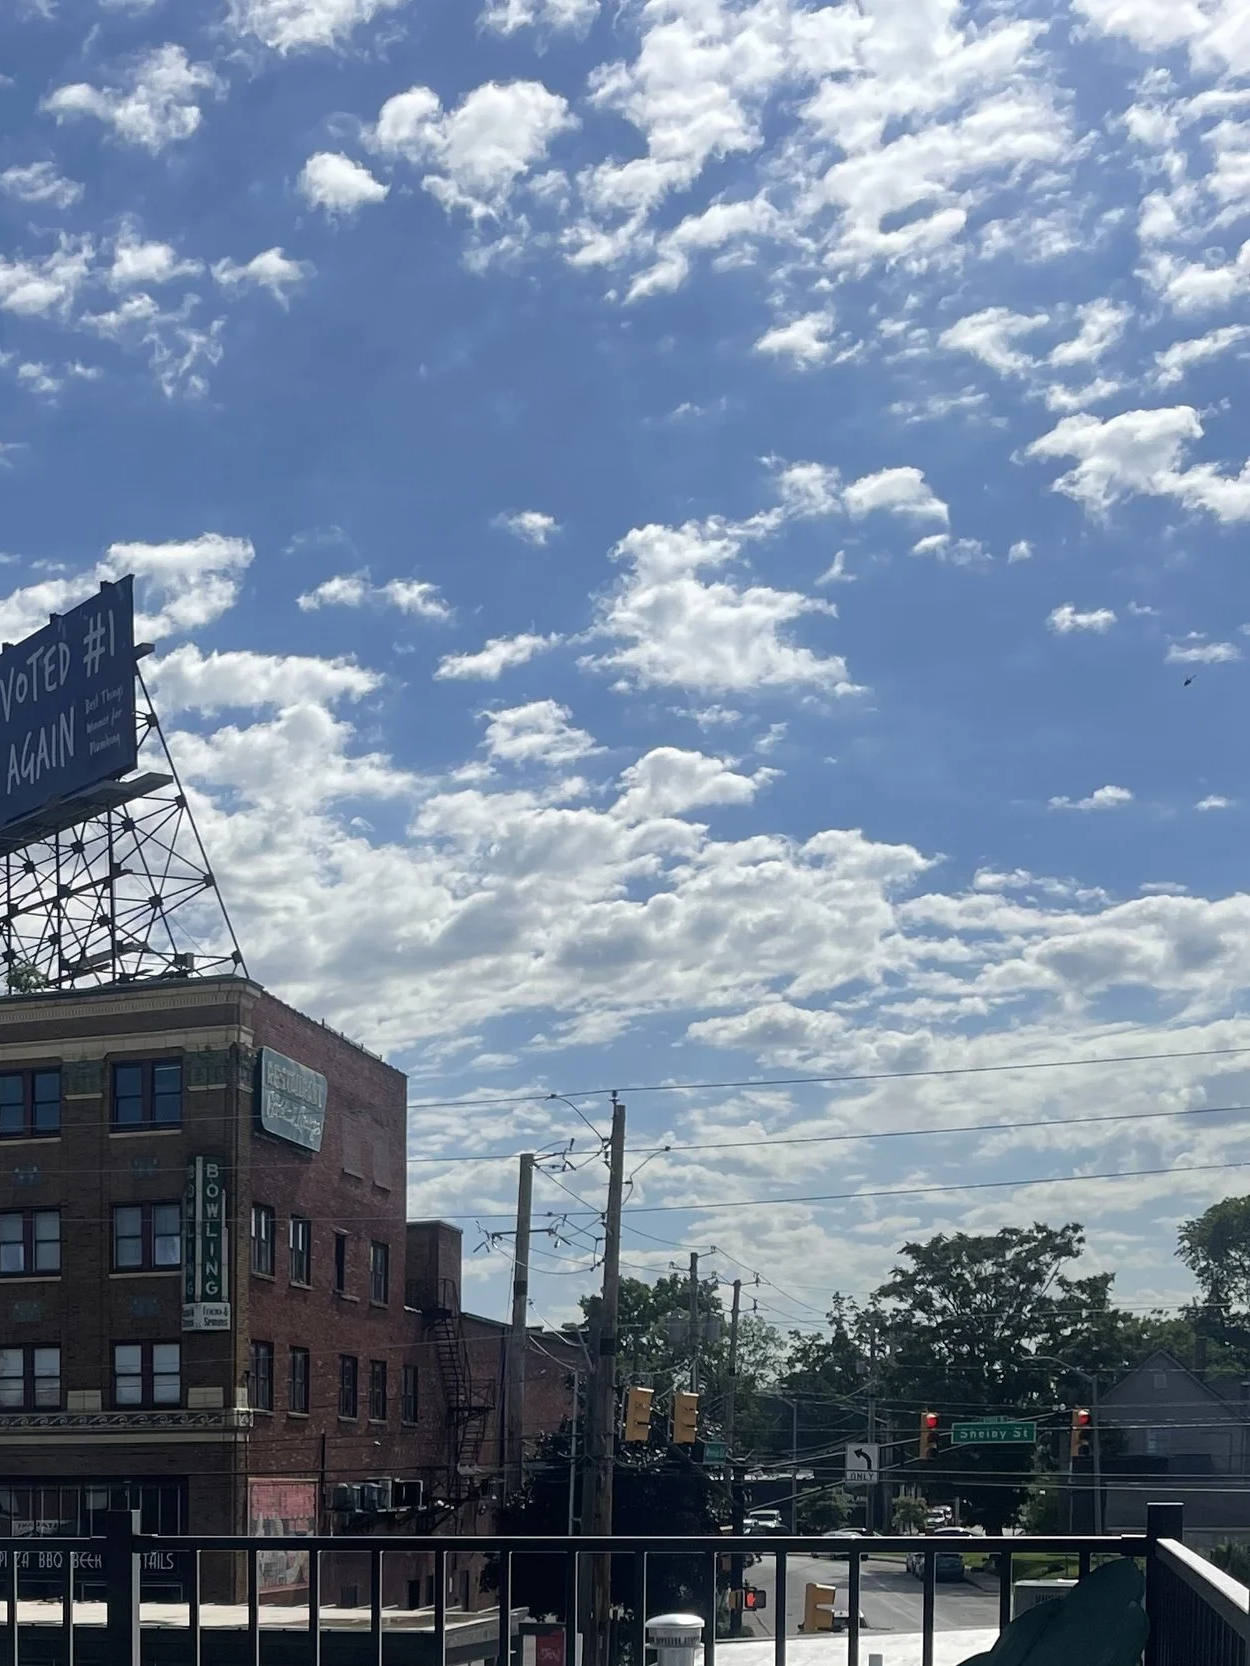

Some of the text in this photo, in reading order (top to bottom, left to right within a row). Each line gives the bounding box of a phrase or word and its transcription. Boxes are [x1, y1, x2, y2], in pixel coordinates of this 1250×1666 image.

[0, 609, 116, 722] VOTED #1
[6, 706, 75, 795] AGAIN
[205, 1163, 219, 1296] BOWLING
[959, 1427, 1028, 1440] Shelby St
[850, 1472, 874, 1481] ONLY
[38, 1551, 63, 1568] BBQ
